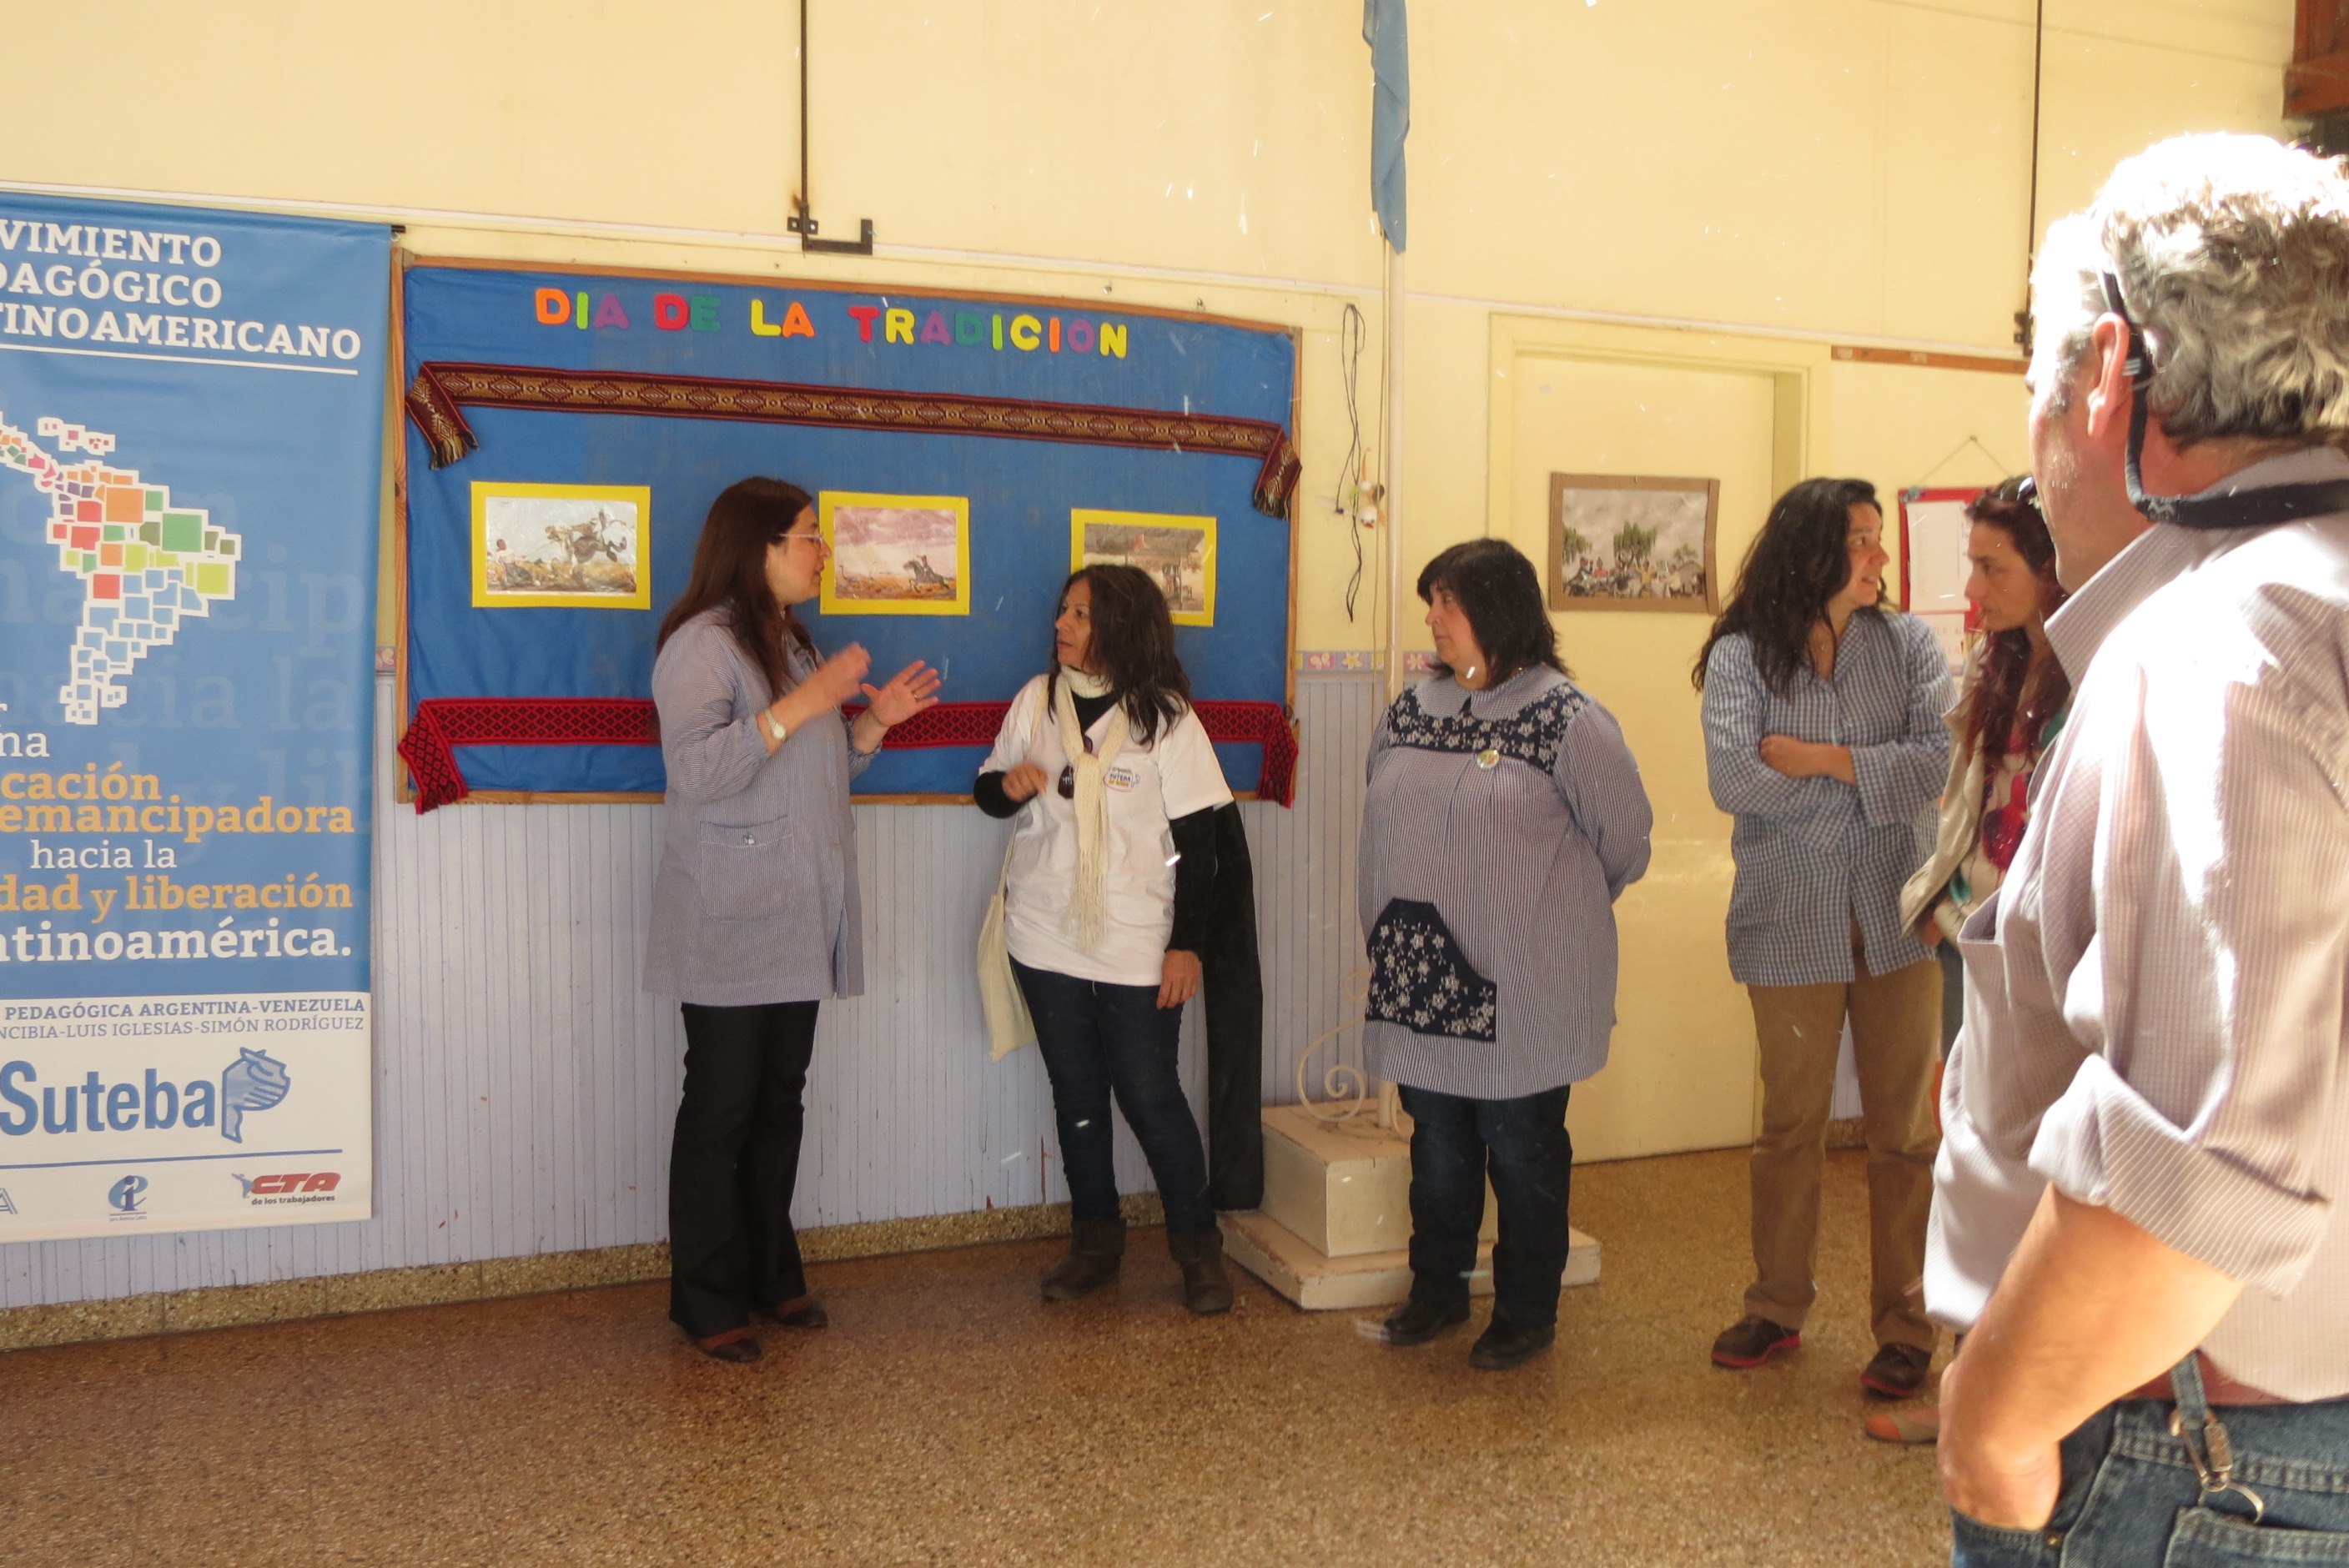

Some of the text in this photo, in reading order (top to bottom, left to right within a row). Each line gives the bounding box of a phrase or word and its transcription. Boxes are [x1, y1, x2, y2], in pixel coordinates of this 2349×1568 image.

[0, 219, 222, 267] VIMIENTO
[0, 259, 223, 309] AGÓGICO
[0, 302, 361, 360] INOAMERICANO
[535, 288, 1128, 359] DIA DE LA TRADICION
[2, 761, 162, 801] cación
[0, 796, 355, 843] emancipadora
[30, 839, 178, 869] hacia la
[0, 872, 353, 924] dad y liberación
[5, 998, 365, 1020] PEDAGÓGICA ARGENTINA-VENEZUELA
[112, 1017, 259, 1036] IGLESIAS-SIMÓN
[264, 1014, 365, 1032] RODRÍGUEZ
[0, 1060, 216, 1136] Suteba
[251, 1172, 341, 1194] CTA
